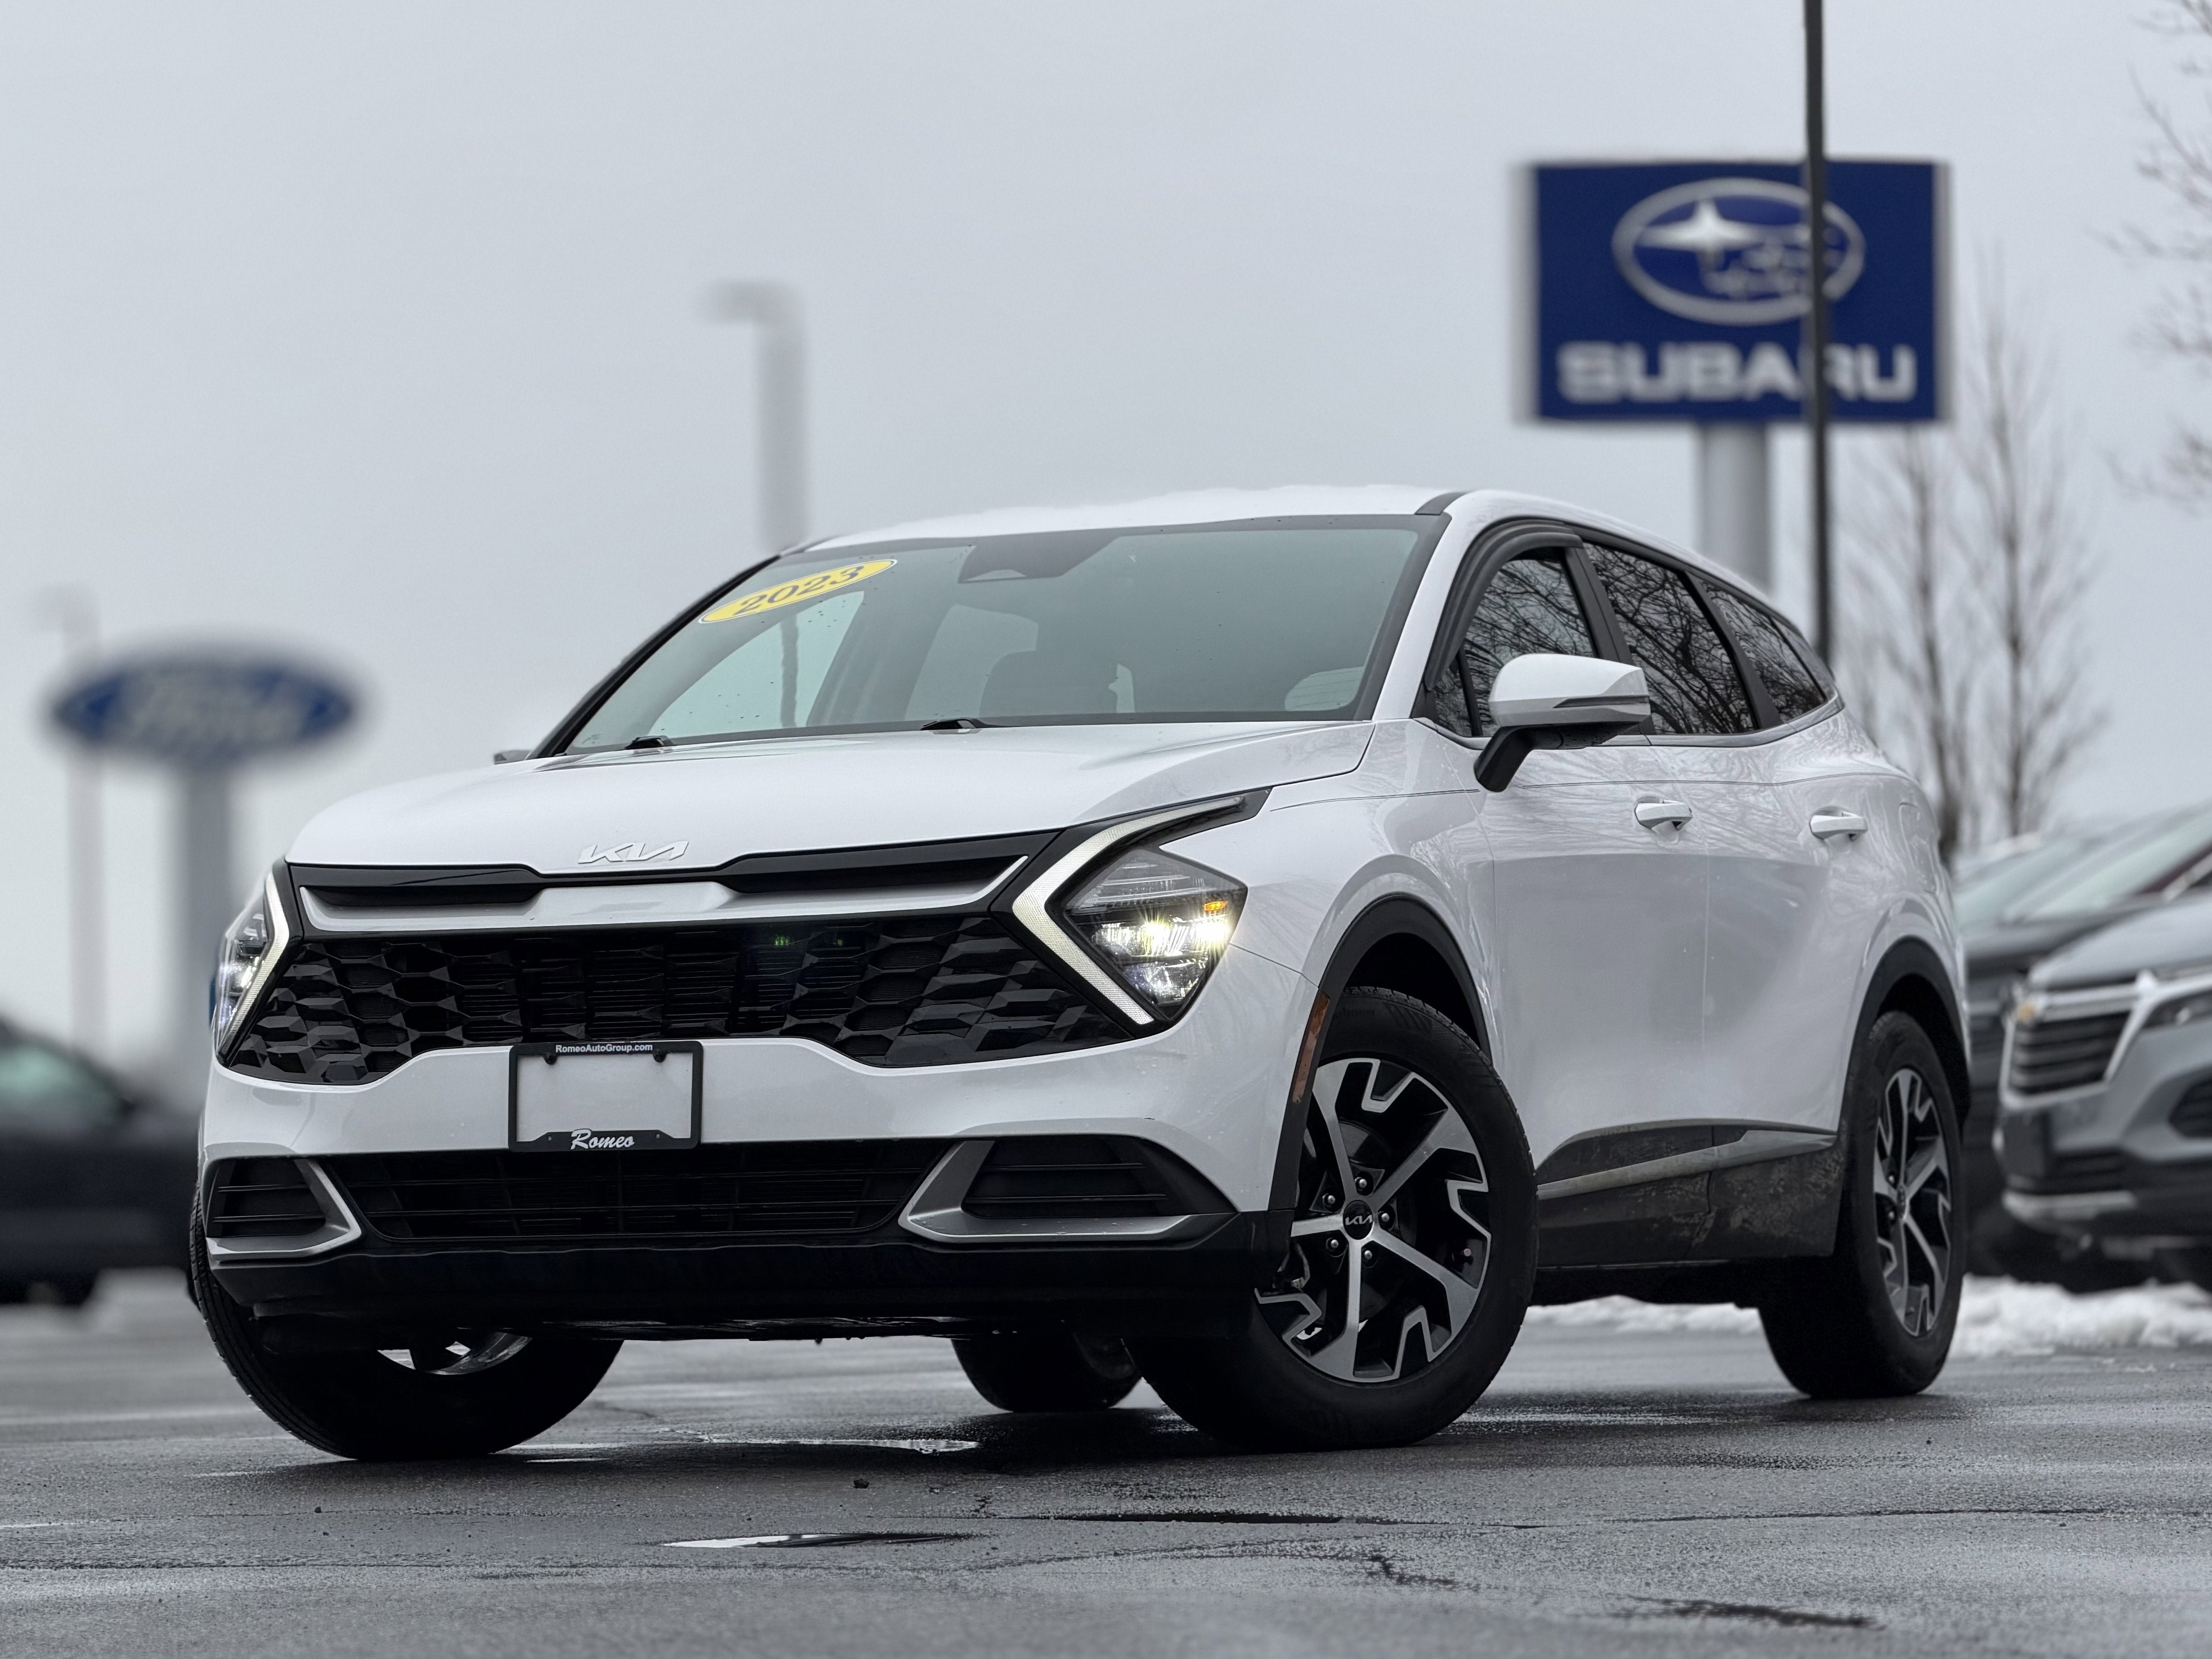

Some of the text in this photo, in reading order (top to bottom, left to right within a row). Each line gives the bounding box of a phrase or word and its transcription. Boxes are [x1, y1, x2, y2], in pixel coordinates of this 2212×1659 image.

[733, 565, 864, 616] 2023
[578, 841, 689, 864] KIA
[555, 1044, 653, 1053] RomeoAutoGroup.com
[570, 1129, 634, 1150] Romeo
[1345, 1214, 1372, 1226] KIA
